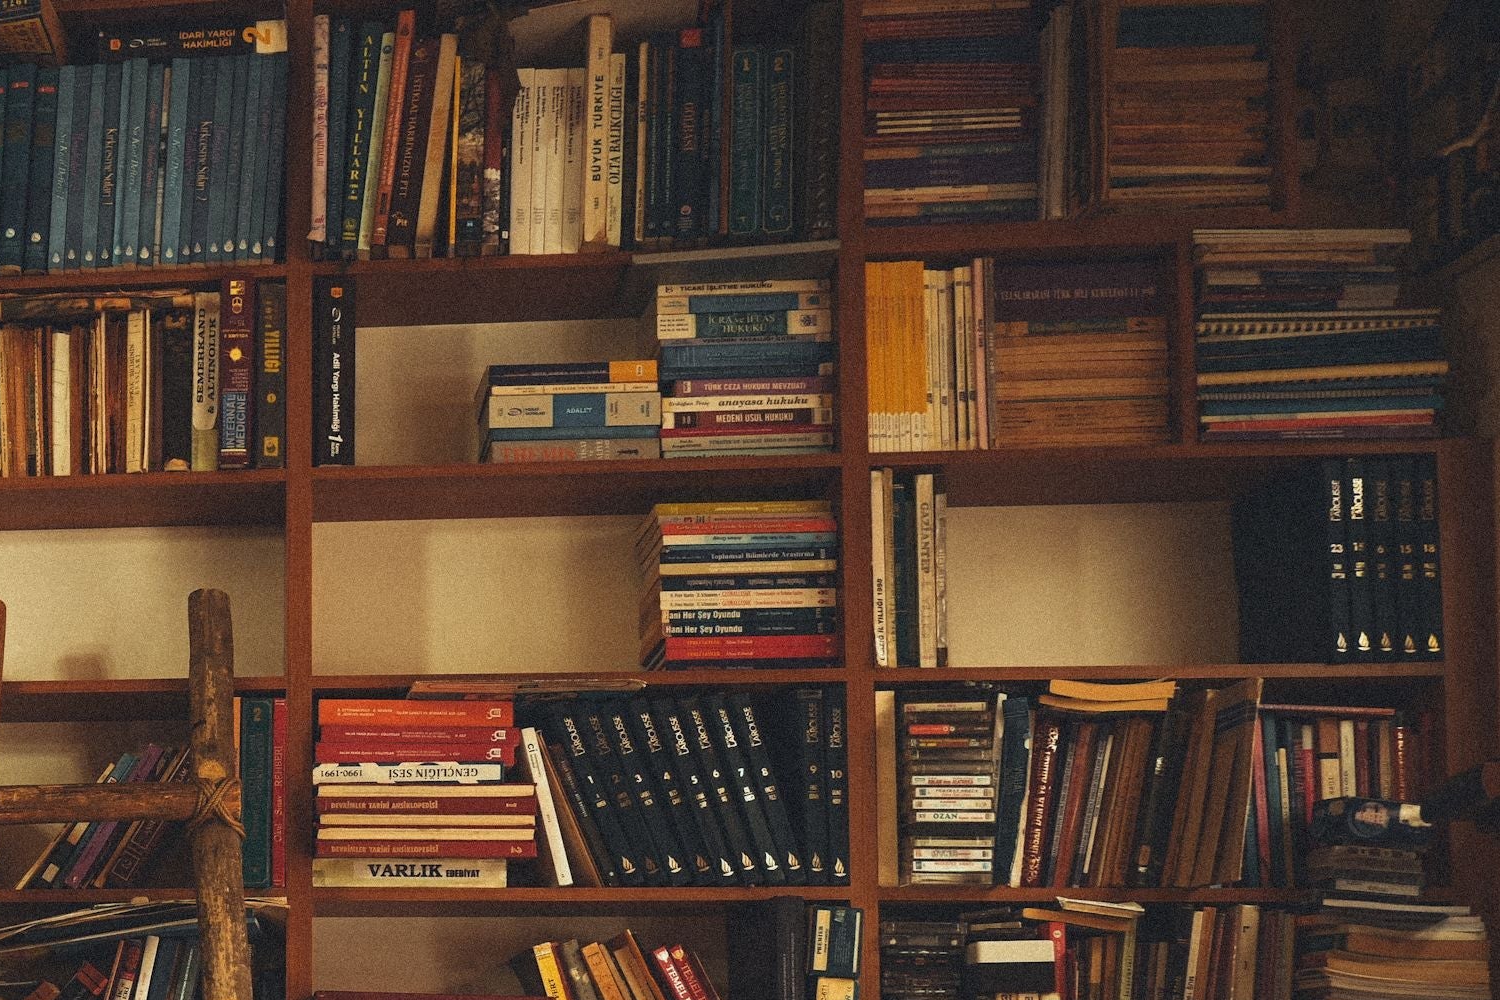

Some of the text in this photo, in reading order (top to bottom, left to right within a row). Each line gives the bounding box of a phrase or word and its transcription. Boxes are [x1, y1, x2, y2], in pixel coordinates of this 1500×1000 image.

[208, 28, 235, 38] YARGI
[358, 34, 373, 95] ALTIN
[592, 74, 605, 182] BÜYÜK TÜRKİYE
[608, 157, 619, 185] OLTA
[196, 307, 207, 405] SEMERKAND
[207, 315, 217, 401] ALTINOLUK
[703, 382, 722, 391] TÜRK
[723, 382, 741, 391] CEZA
[718, 396, 808, 408] anayasa hukuku
[222, 393, 234, 449] INTERNAL
[234, 393, 246, 450] MEDICINE
[715, 412, 794, 423] MEDENİ USUL HUKUKU
[1350, 477, 1364, 520] LAROUSSE
[1330, 543, 1344, 554] 23
[682, 611, 695, 620] Her
[697, 611, 711, 621] Şey
[713, 610, 741, 620] Oyundu
[665, 625, 743, 635] Hani Her Şey Oyundu
[612, 714, 634, 755] LAROUSSE
[640, 711, 663, 753] LAROUSSE
[691, 709, 712, 750] LAROUSSE
[718, 708, 738, 749] LAROUSSE
[742, 706, 763, 748] LAROUSSE
[830, 707, 843, 748] LAROUSSE
[563, 716, 586, 757] LAROUSSE
[668, 715, 690, 756] LAROUSSE
[388, 765, 479, 778] GENÇLİĞİN SESİ
[662, 772, 671, 781] 4
[712, 769, 720, 778] 6
[737, 767, 745, 777] 7
[761, 767, 769, 777] 8
[809, 765, 817, 774] 9
[830, 769, 843, 779] 10
[587, 775, 594, 784] 1
[634, 774, 643, 783] 3
[690, 775, 699, 785] 5
[932, 812, 958, 820] OZAN
[367, 863, 480, 878] VARLIK EDEBİYAT
[816, 925, 824, 955] PREMIER
[681, 961, 702, 998] TEMEL
